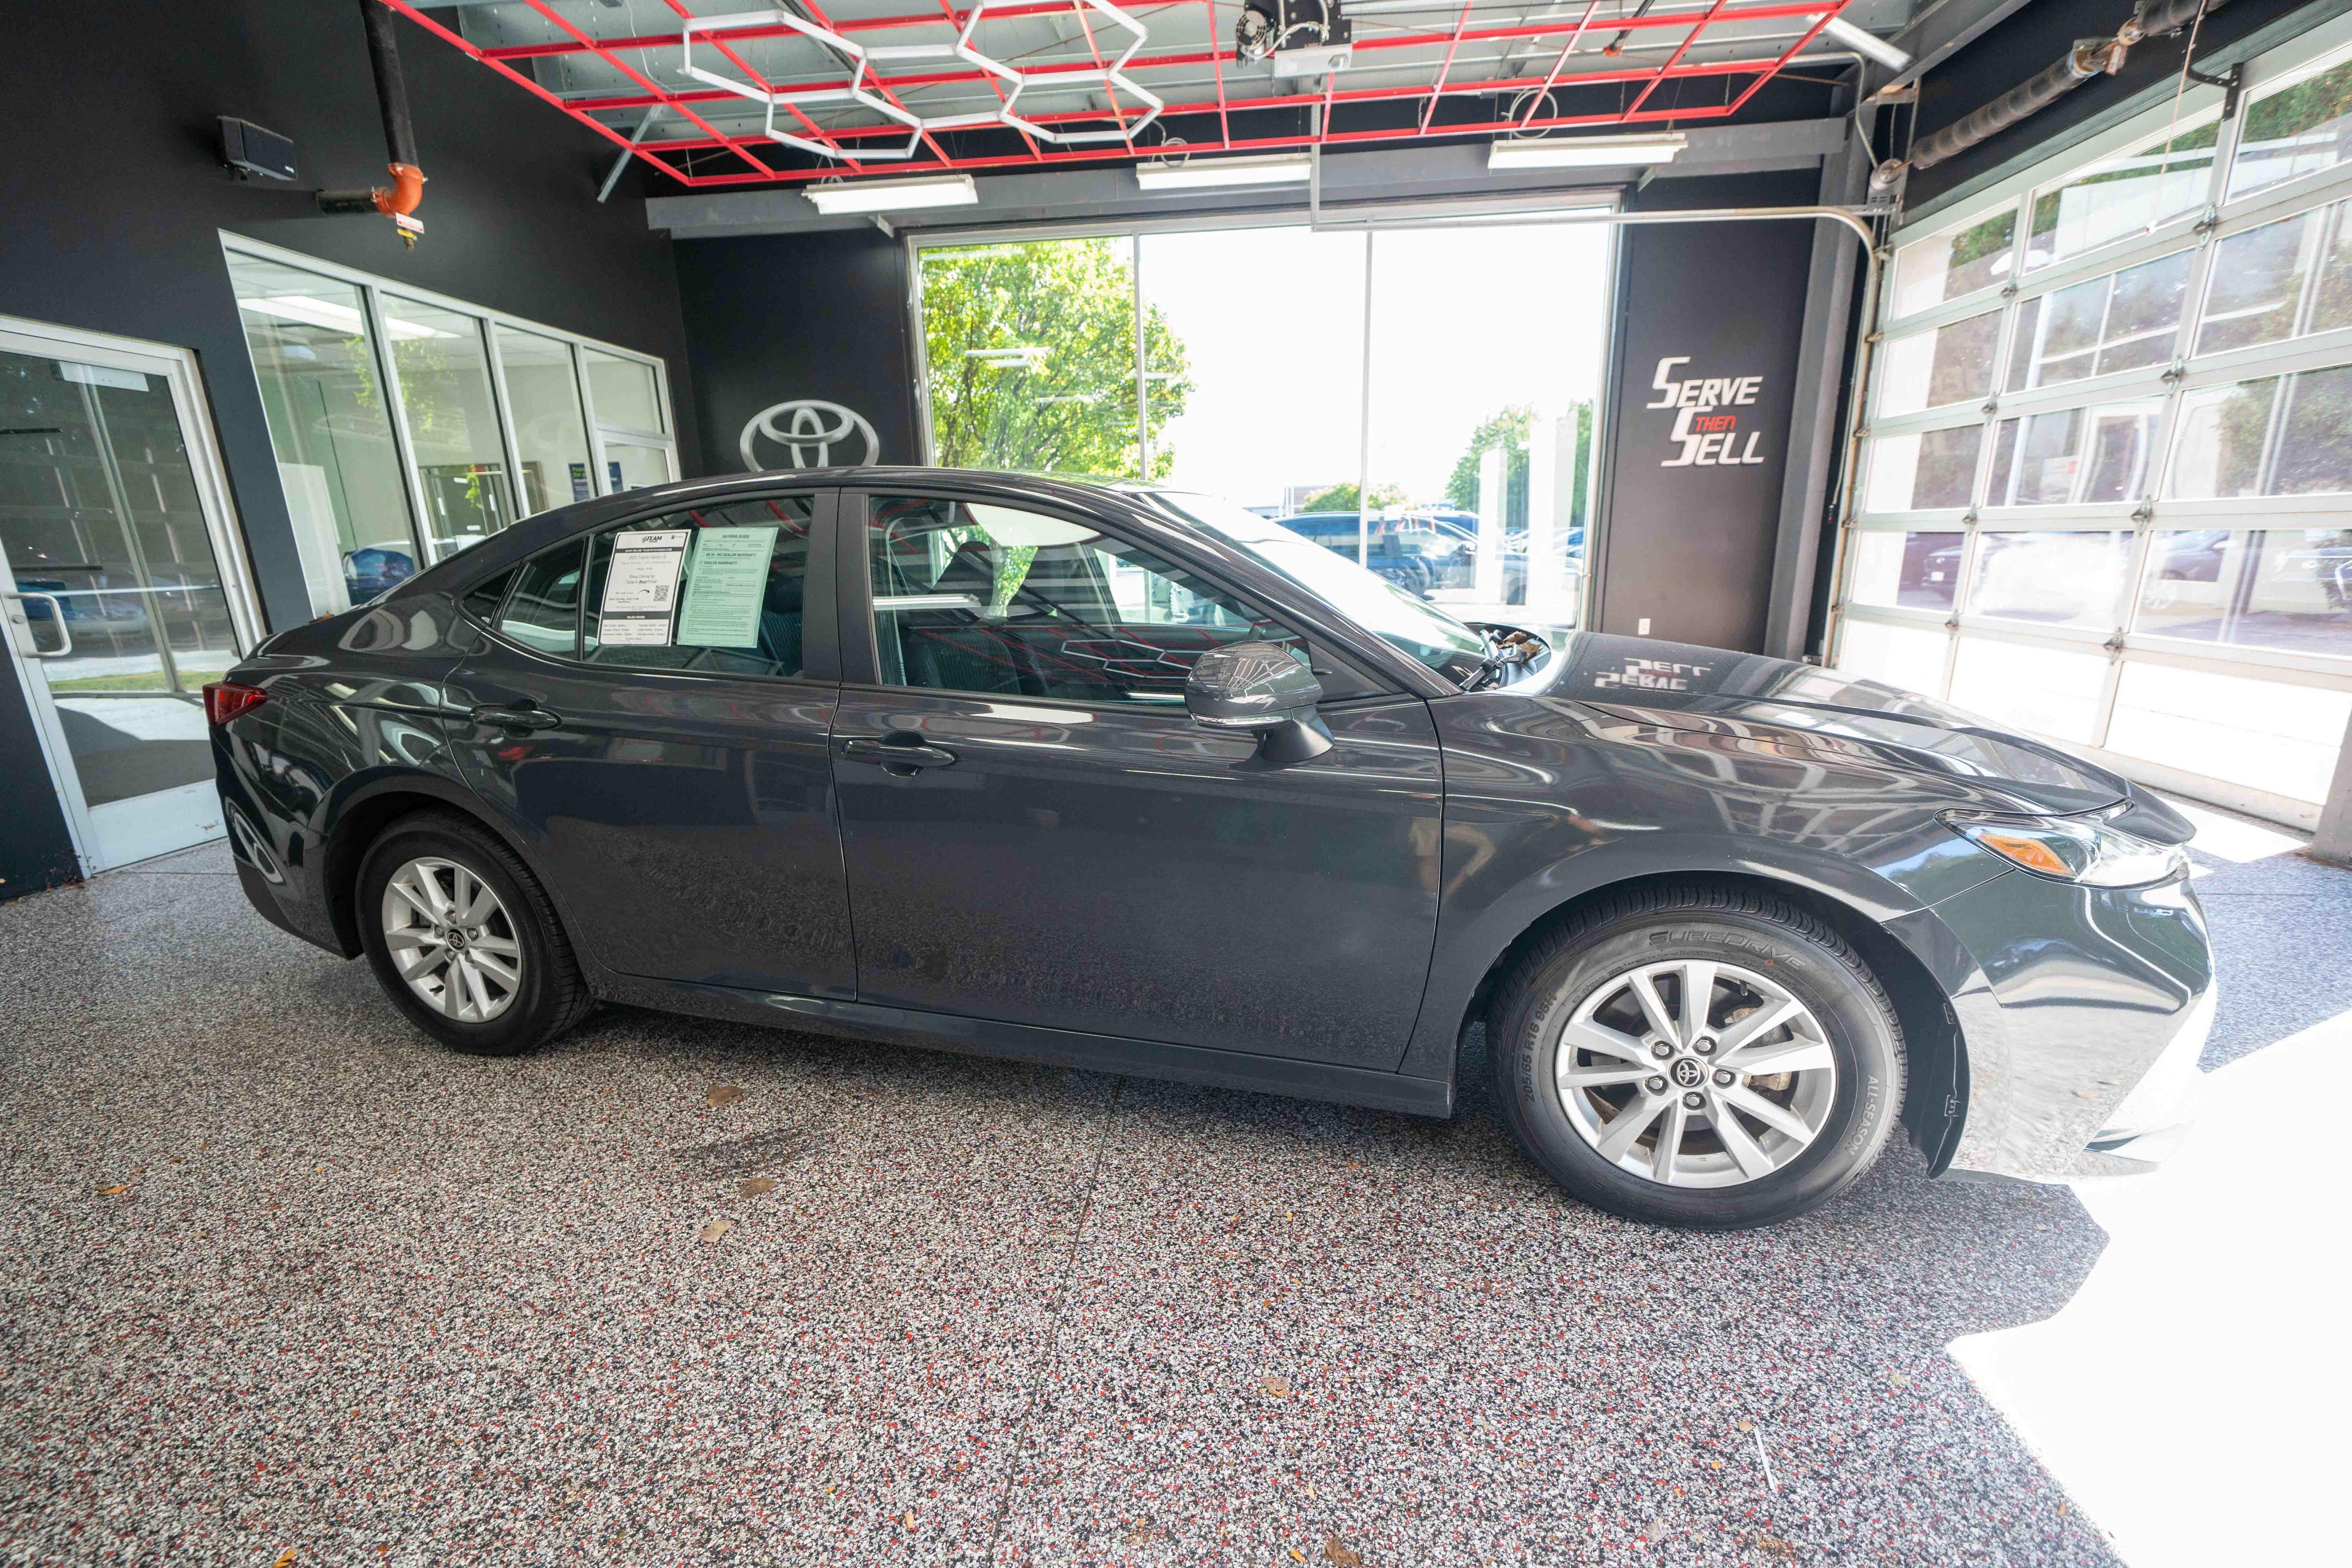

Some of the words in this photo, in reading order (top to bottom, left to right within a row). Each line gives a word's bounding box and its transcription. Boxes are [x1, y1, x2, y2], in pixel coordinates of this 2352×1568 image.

[1646, 356, 1763, 409] SERVE
[1661, 405, 1765, 467] SELL
[1695, 415, 1736, 431] THEN
[1524, 1022, 1540, 1051] R16
[1521, 1054, 1535, 1102] 205/65
[1844, 1074, 1879, 1156] ALL-SEASON
